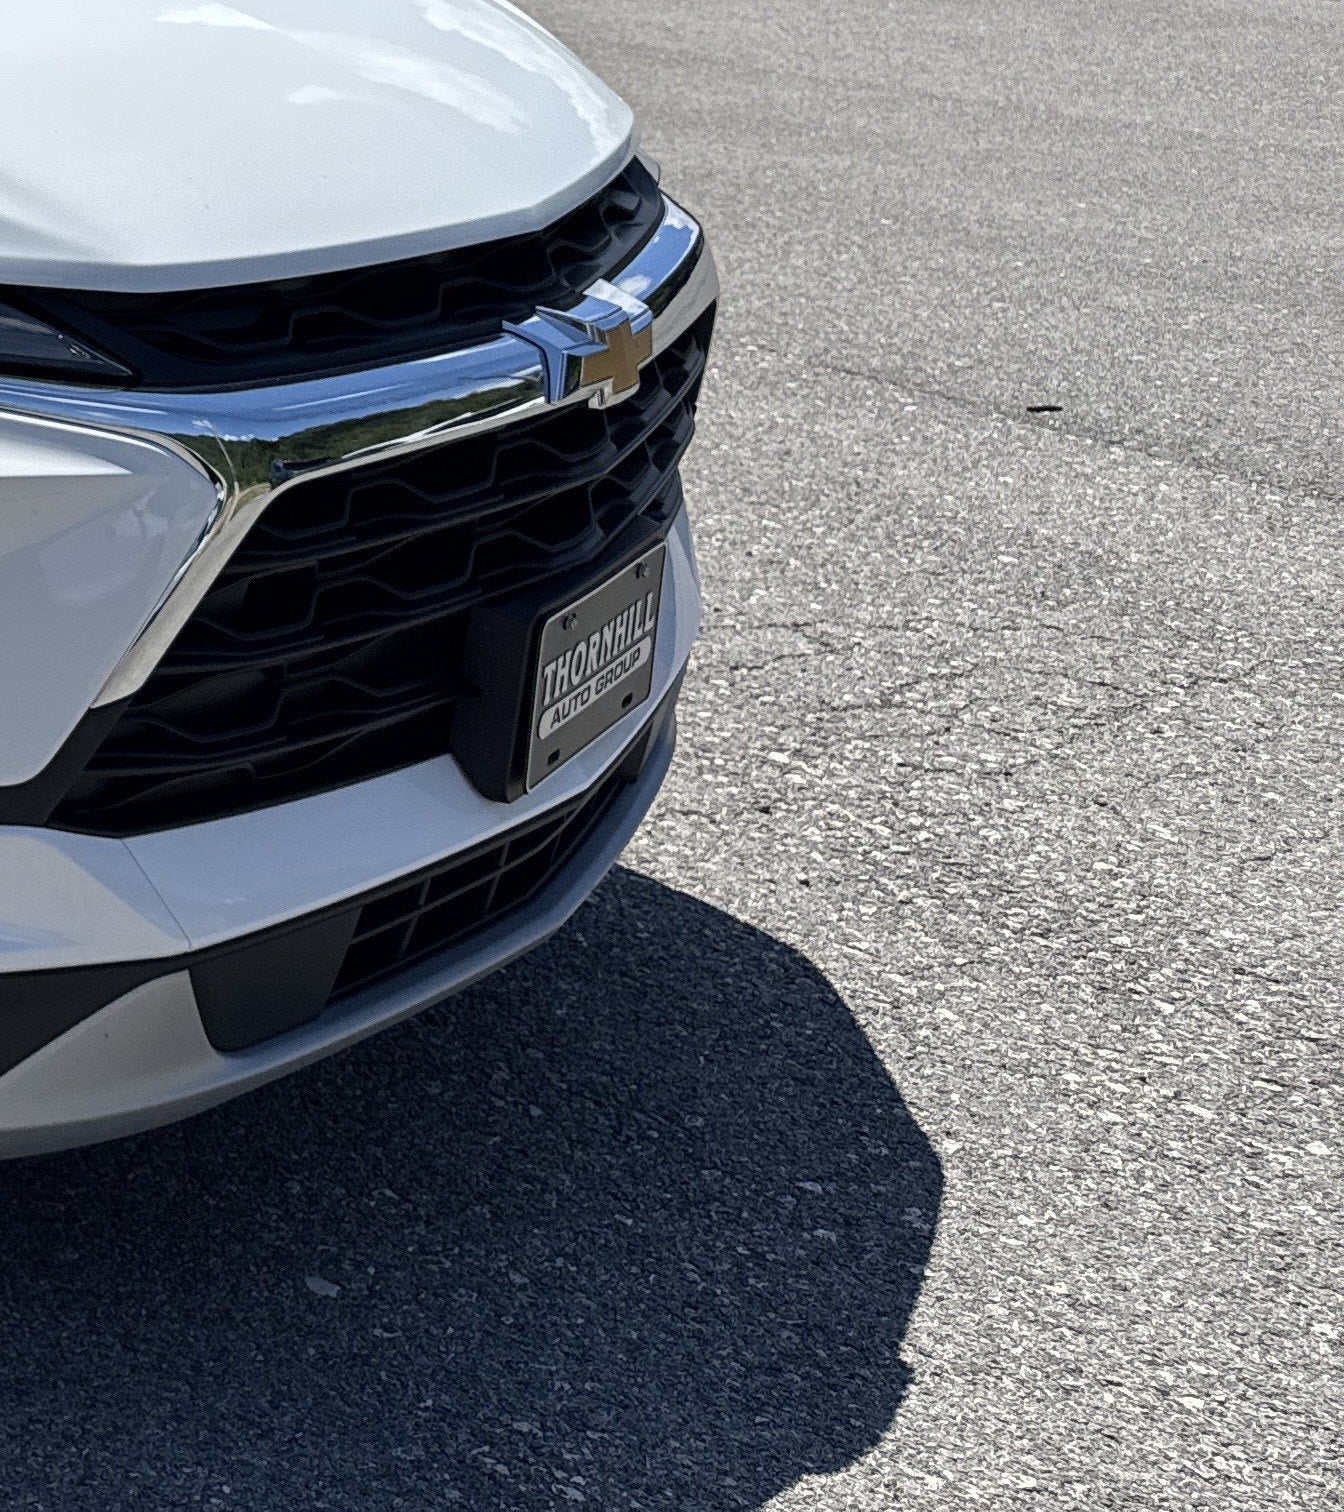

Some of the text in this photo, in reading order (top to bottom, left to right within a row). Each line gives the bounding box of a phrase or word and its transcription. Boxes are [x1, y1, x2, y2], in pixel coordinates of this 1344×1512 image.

[542, 591, 655, 706] THORNHILL
[549, 647, 641, 730] AUTO GROUP
